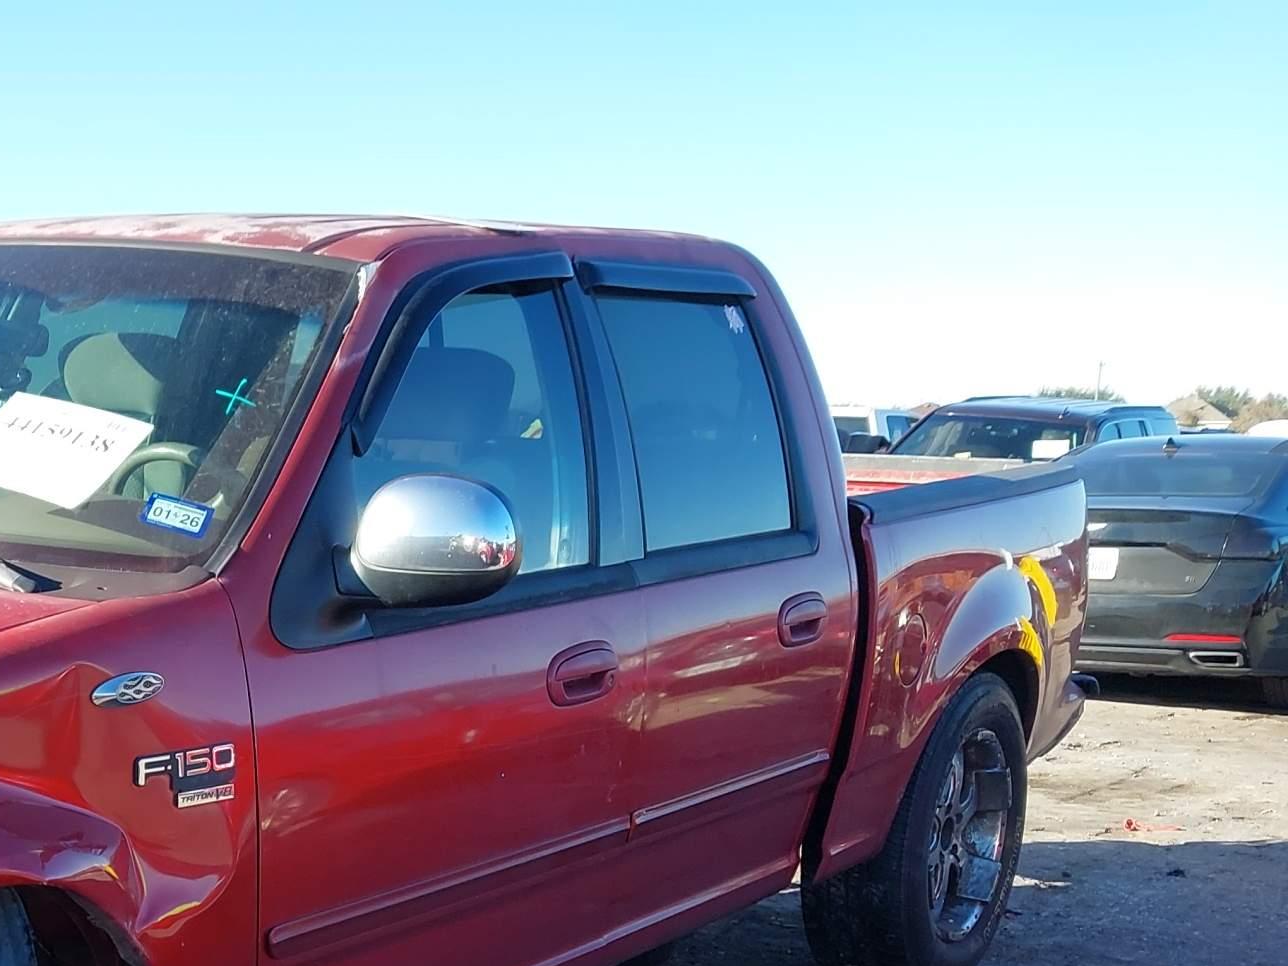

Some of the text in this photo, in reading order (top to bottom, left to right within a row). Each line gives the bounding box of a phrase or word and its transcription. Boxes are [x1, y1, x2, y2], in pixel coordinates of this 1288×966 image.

[153, 506, 201, 528] 01 26
[180, 785, 233, 804] TRITON V8
